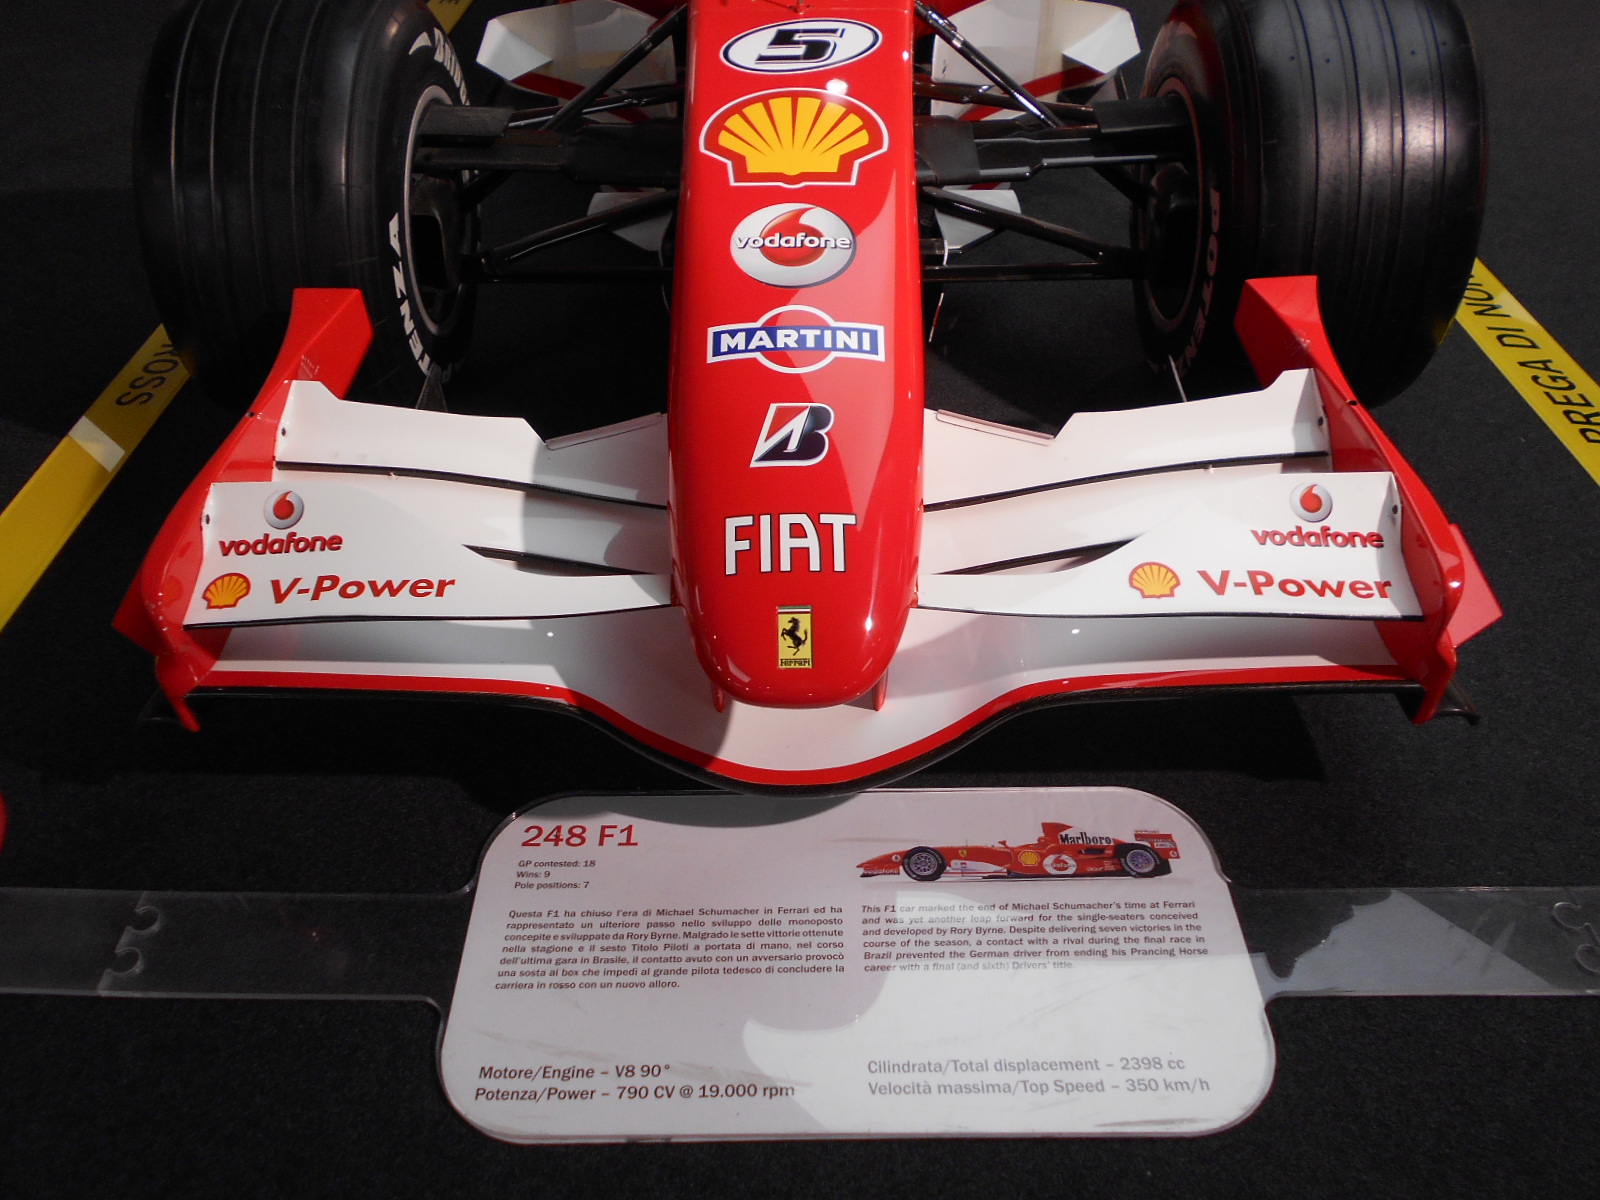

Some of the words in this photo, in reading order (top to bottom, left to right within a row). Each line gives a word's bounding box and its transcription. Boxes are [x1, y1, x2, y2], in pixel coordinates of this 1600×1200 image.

[755, 28, 845, 64] 5
[735, 233, 852, 249] vodafone
[720, 329, 871, 352] MARTINI
[1486, 326, 1541, 349] DI
[218, 532, 343, 557] vodafone
[725, 513, 857, 576] FIAT
[1250, 525, 1385, 548] vodafone
[270, 575, 456, 604] V-Power
[1197, 570, 1393, 599] V-Power
[780, 658, 811, 667] Ferrari
[520, 824, 588, 847] 248
[597, 824, 639, 846] F1
[1060, 831, 1112, 845] Marlboro
[517, 858, 532, 867] GP
[533, 859, 580, 867] contested:
[583, 858, 596, 867] 18
[515, 869, 541, 878] Wins:
[543, 869, 551, 877] 9
[513, 880, 535, 889] Pole
[535, 880, 581, 890] positions:
[583, 879, 589, 888] 7
[507, 908, 543, 919] Questa
[546, 908, 560, 917] F1
[563, 908, 576, 917] ha
[580, 907, 613, 916] chiuso
[616, 907, 638, 916] l'era
[642, 907, 652, 916] di
[655, 906, 694, 915] Michael
[698, 905, 759, 915] Schumacher
[763, 905, 772, 914] in
[777, 905, 809, 914] Ferrari
[813, 904, 825, 913] ed
[830, 904, 842, 913] ha
[505, 919, 575, 931] rappresentato
[599, 918, 640, 928] ulteriore
[646, 920, 675, 929] passo
[681, 917, 705, 926] nello
[711, 917, 751, 928] sviluppo
[758, 916, 781, 926] delle
[788, 916, 843, 927] monoposto
[861, 926, 881, 935] and
[883, 925, 934, 937] developed
[935, 925, 947, 936] by
[949, 924, 972, 936] Rory
[974, 924, 1005, 935] Byrne.
[1008, 924, 1046, 935] Despite
[1047, 923, 1097, 934] delivering
[1128, 922, 1171, 931] victories
[1172, 922, 1183, 931] in
[1184, 922, 1202, 931] the
[503, 931, 552, 943] concepite
[559, 930, 611, 942] sviluppate
[611, 930, 624, 939] da
[625, 930, 649, 941] Rory
[649, 929, 680, 941] Byrne.
[682, 929, 729, 940] Malgrado
[730, 929, 739, 938] le
[740, 928, 764, 938] sette
[766, 928, 800, 937] vittorie
[802, 927, 843, 937] ottenute
[501, 943, 526, 952] nella
[530, 942, 573, 954] stagione
[589, 942, 595, 951] il
[599, 942, 627, 951] sesto
[631, 941, 658, 951] Titolo
[663, 941, 688, 950] Piloti
[704, 940, 740, 952] portata
[746, 940, 755, 949] di
[760, 942, 791, 951] mano,
[796, 939, 811, 948] nel
[863, 949, 892, 959] Brazil
[895, 949, 945, 961] prevented
[948, 948, 965, 958] the
[968, 948, 1009, 958] German
[1012, 947, 1042, 957] driver
[1045, 947, 1070, 956] from
[1072, 946, 1108, 958] ending
[1110, 946, 1126, 956] his
[1129, 946, 1176, 957] Prancing
[1177, 945, 1209, 955] Horse
[498, 954, 553, 964] dell'ultima
[554, 956, 578, 966] gara
[580, 954, 590, 963] in
[592, 953, 630, 965] Brasile,
[632, 953, 639, 963] il
[640, 953, 682, 962] contatto
[685, 952, 712, 962] avuto
[715, 954, 733, 962] con
[751, 951, 802, 961] avversario
[805, 950, 844, 962] provocò
[518, 967, 546, 977] sosta
[561, 966, 579, 976] box
[581, 966, 600, 976] che
[602, 966, 638, 978] impedì
[640, 965, 650, 975] al
[652, 965, 688, 977] grande
[690, 964, 719, 976] pilota
[722, 964, 762, 974] tedesco
[764, 964, 774, 973] di
[776, 963, 832, 973] concludere
[835, 963, 844, 972] la
[494, 979, 534, 989] carriera
[536, 979, 546, 989] in
[548, 981, 576, 989] rosso
[615, 980, 646, 988] nuovo
[648, 977, 680, 987] alloro.
[477, 1064, 595, 1082] Motore/Engine
[614, 1064, 635, 1077] V8
[867, 1058, 989, 1075] Cilindrata/Total
[992, 1057, 1100, 1074] displacement
[1119, 1056, 1163, 1070] 2398
[1167, 1058, 1185, 1069] cc
[473, 1086, 595, 1103] Potenza/Power
[616, 1085, 649, 1099] 790
[653, 1085, 674, 1098] CV
[678, 1084, 693, 1098] @
[698, 1083, 757, 1097] 19.000
[762, 1085, 794, 1099] rpm
[868, 1080, 931, 1095] Velocità
[936, 1079, 1050, 1096] massima/Top
[1052, 1078, 1105, 1095] Speed
[1124, 1077, 1159, 1092] 350
[1162, 1077, 1210, 1093] km/h
